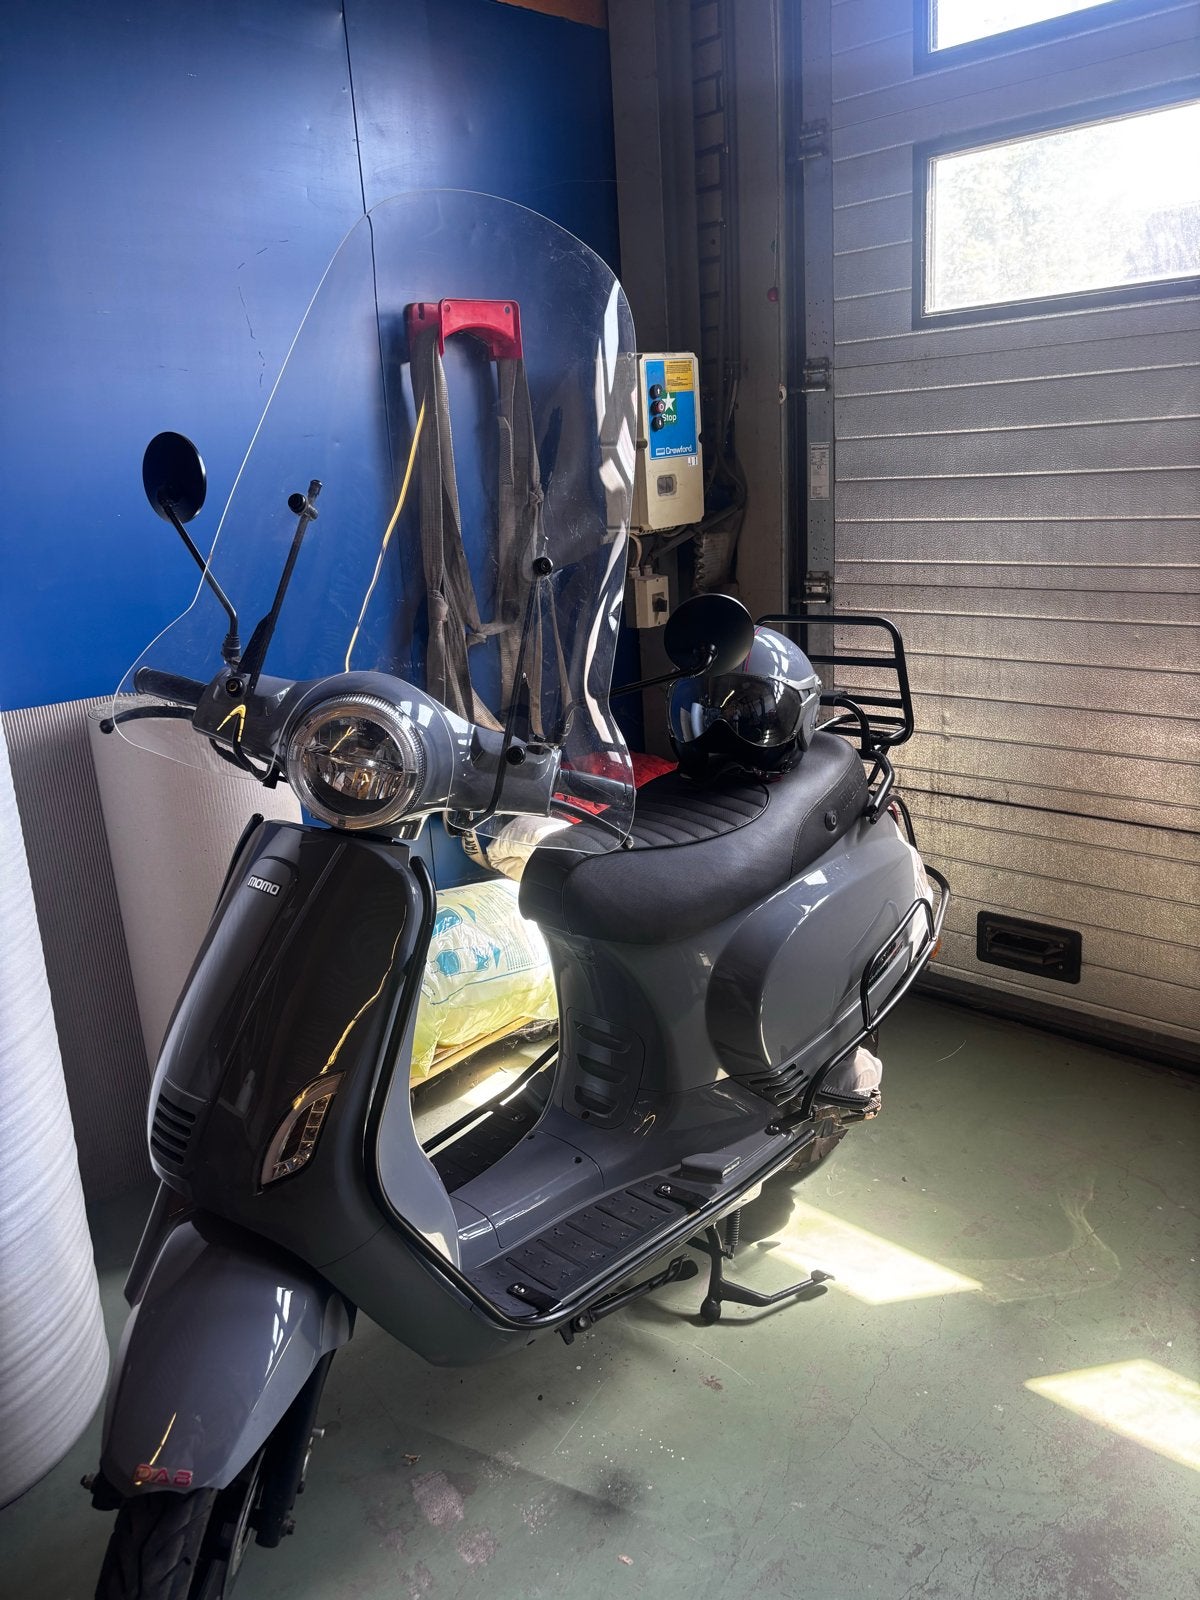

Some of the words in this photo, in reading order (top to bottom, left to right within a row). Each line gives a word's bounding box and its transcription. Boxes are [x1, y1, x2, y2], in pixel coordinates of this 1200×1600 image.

[662, 413, 677, 423] Stop
[665, 444, 693, 455] Crawford
[134, 1464, 193, 1487] DAB
